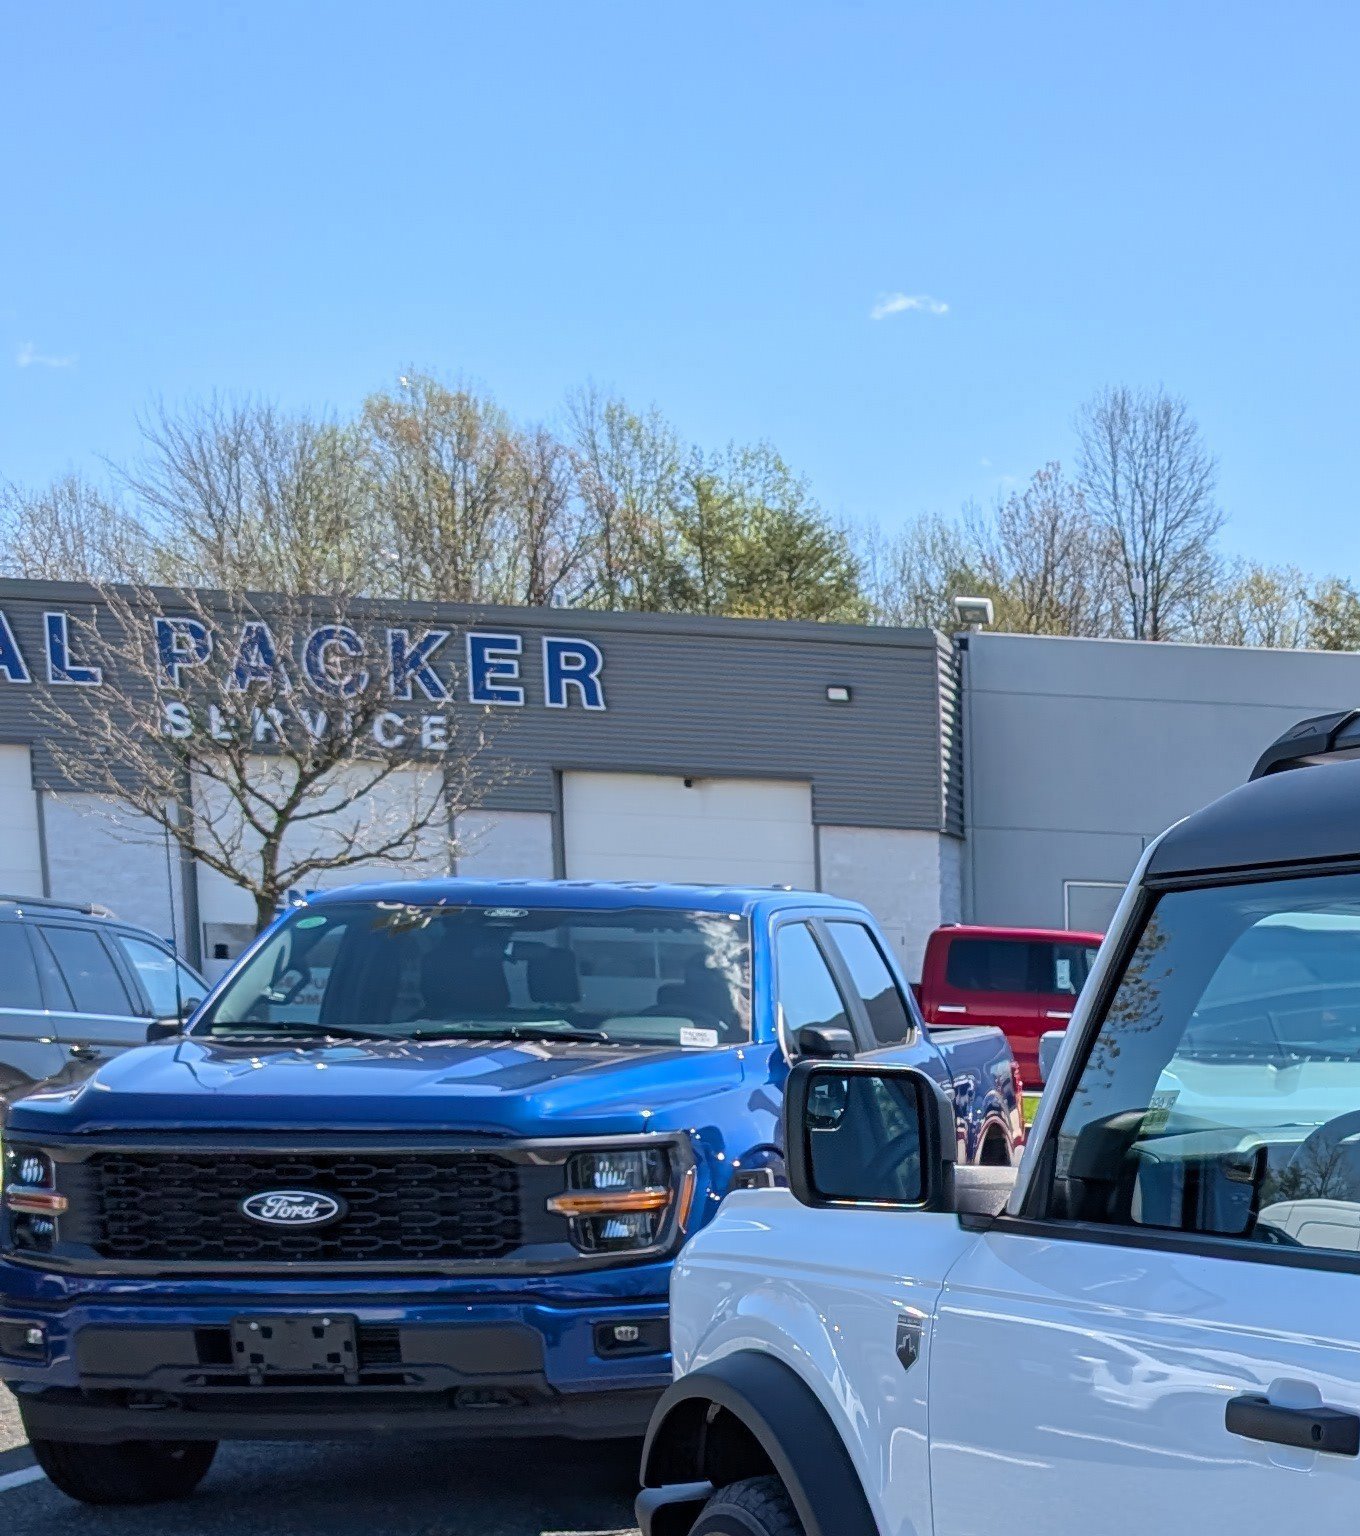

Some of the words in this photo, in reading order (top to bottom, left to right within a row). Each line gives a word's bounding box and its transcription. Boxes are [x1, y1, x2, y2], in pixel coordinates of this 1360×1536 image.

[155, 616, 607, 711] PACKER
[163, 701, 449, 751] SERVICE
[261, 1195, 319, 1218] Ford
